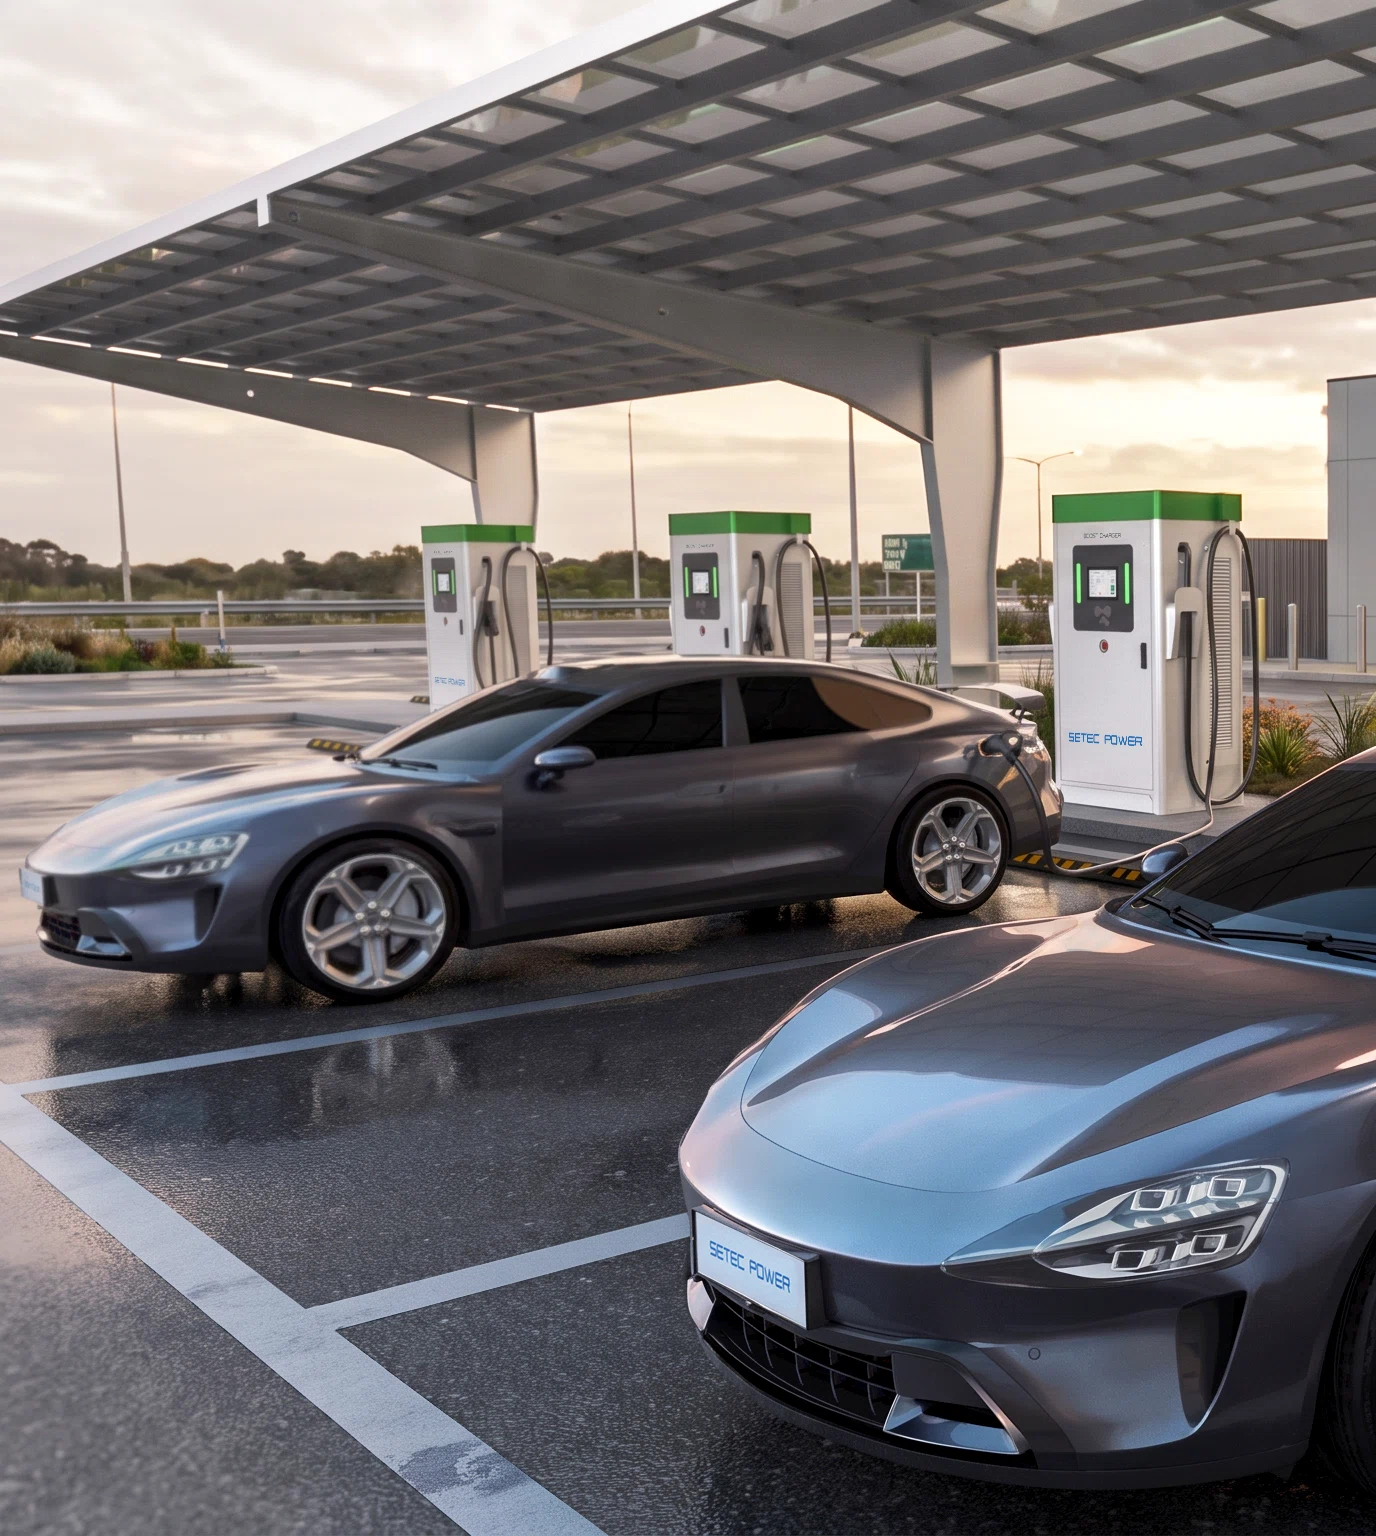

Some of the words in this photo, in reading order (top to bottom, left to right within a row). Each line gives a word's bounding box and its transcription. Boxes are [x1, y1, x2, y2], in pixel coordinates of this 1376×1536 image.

[1068, 732, 1100, 744] SETEC
[1104, 734, 1143, 747] POWER
[709, 1240, 745, 1271] SETEC
[749, 1259, 791, 1294] POWER
